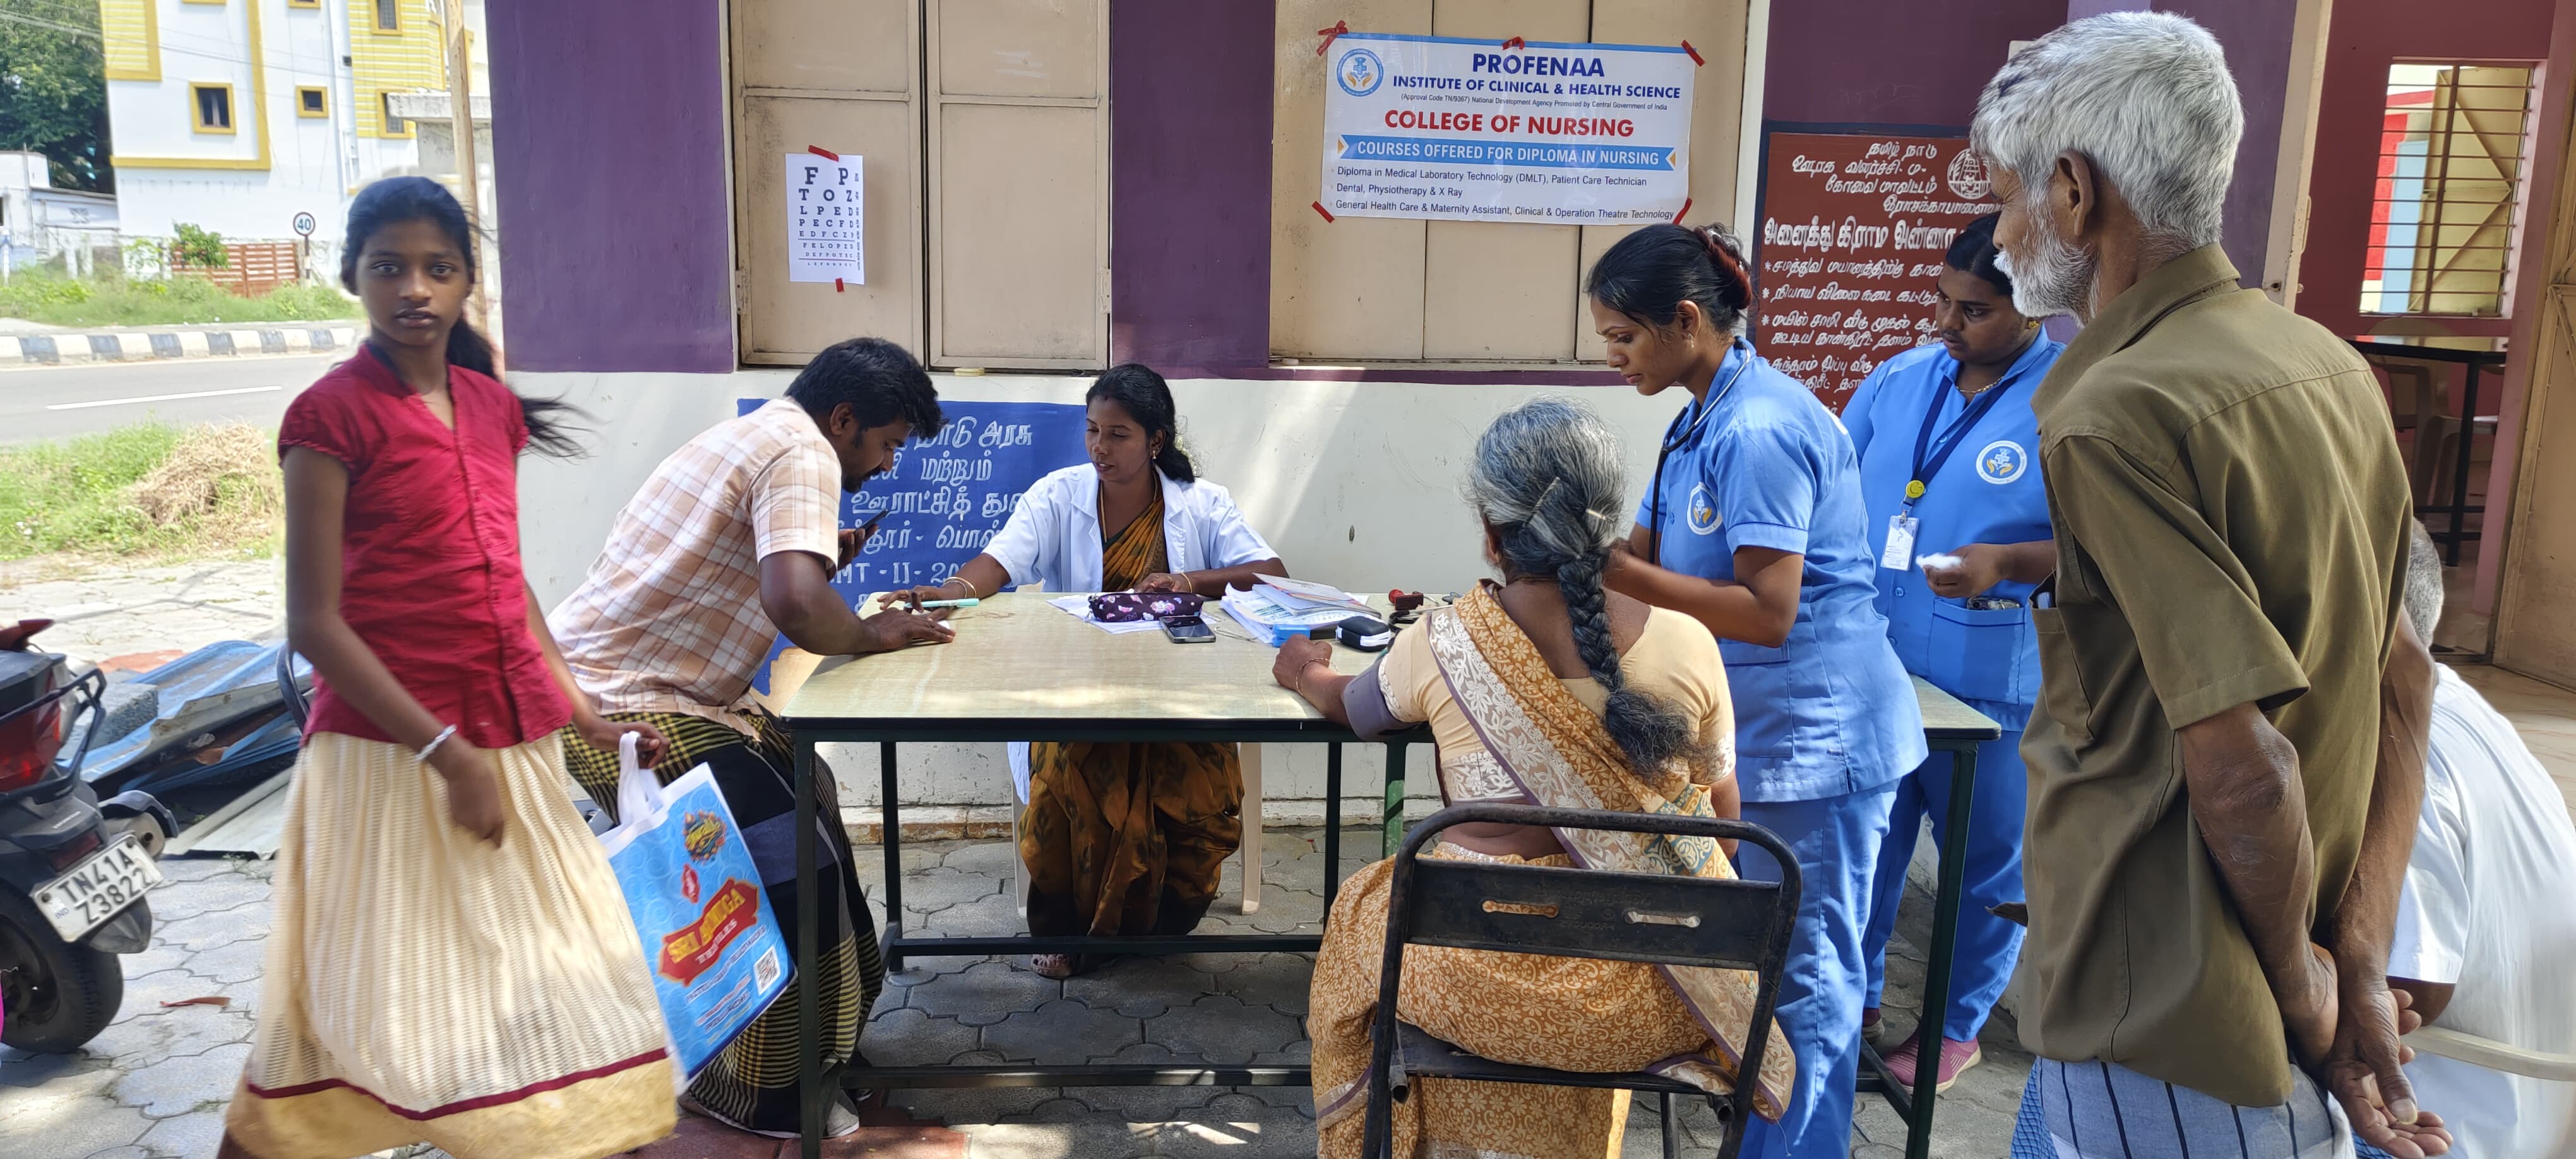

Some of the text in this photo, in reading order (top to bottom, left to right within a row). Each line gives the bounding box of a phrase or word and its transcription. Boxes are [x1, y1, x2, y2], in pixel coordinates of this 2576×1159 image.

[1472, 53, 1605, 77] PROFENAA
[1393, 75, 1681, 98] INSTITUTE OF CLINICAL & HEALTH SCIENCE
[1401, 93, 1428, 101] (Approval
[1445, 95, 1470, 104] TN/9367)
[1496, 97, 1531, 106] Development
[1532, 98, 1553, 108] Agency
[1613, 102, 1646, 110] Government
[1385, 109, 1634, 137] COLLEGE OF NURSING
[1357, 141, 1659, 165] COURSES OFFERED FOR DIPLOMA IN NURSING
[1866, 141, 1938, 162] தமிழ் நாடு
[804, 167, 848, 185] F P
[1337, 167, 1647, 186] Diploma in Medical Laboratory Technology (DMLT), Patient Care Technician
[1825, 173, 1938, 194] கோவை மாவட்டம்
[799, 188, 852, 202] T O Z
[1336, 183, 1463, 198] Dental, Physiotherapy & X Ray
[1335, 199, 1674, 220] General Health Care & Maternity Assistant, Clinical & Operation Theatre Technology
[298, 218, 311, 230] 40
[1764, 215, 1835, 253] அனைத்து
[1837, 215, 1889, 254] கிராம
[978, 420, 1034, 449] அரசு
[921, 449, 993, 487] மற்றும்
[850, 485, 972, 521] ஊராட்சித்
[57, 848, 134, 902] TN41A
[75, 867, 155, 925] Z3822
[55, 907, 69, 920] IND
